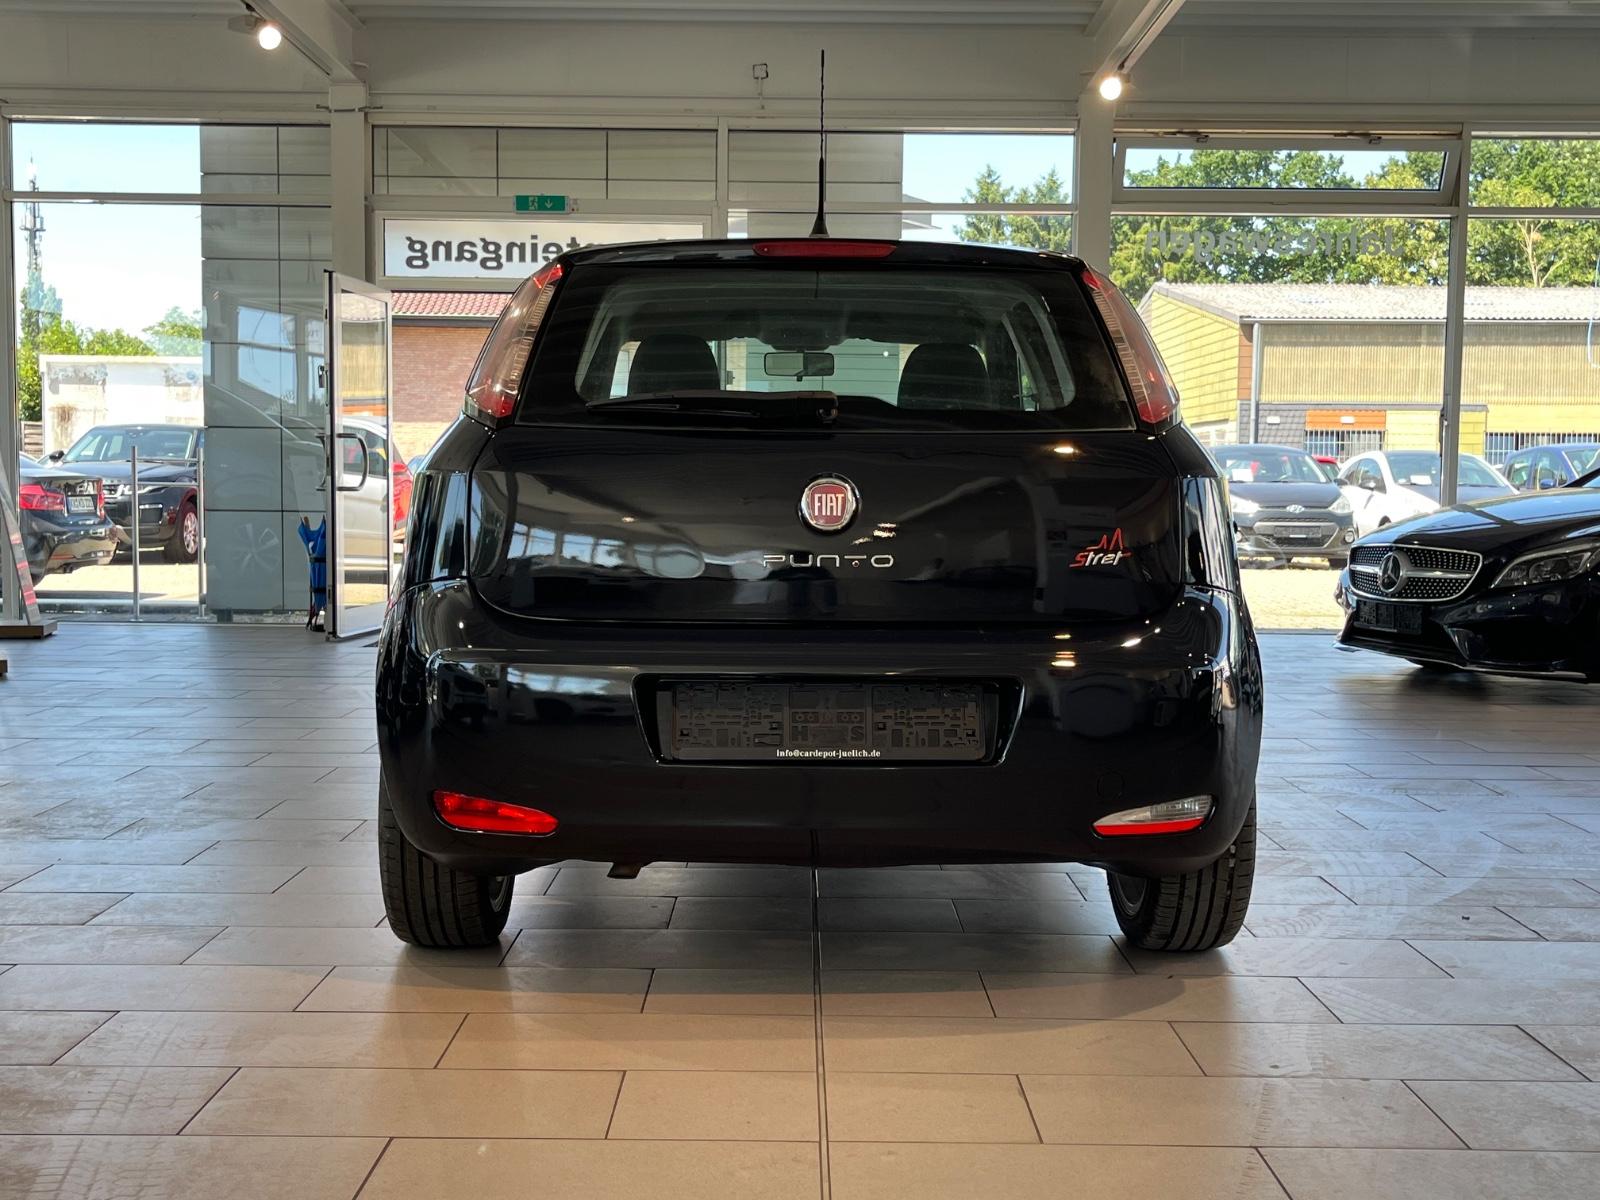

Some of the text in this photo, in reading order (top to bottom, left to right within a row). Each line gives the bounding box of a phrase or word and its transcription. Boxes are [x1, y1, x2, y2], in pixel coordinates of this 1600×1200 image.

[814, 493, 845, 516] FIAT
[763, 554, 894, 568] PUNTO
[776, 749, 881, 759] info@cardepot-juelich.de
